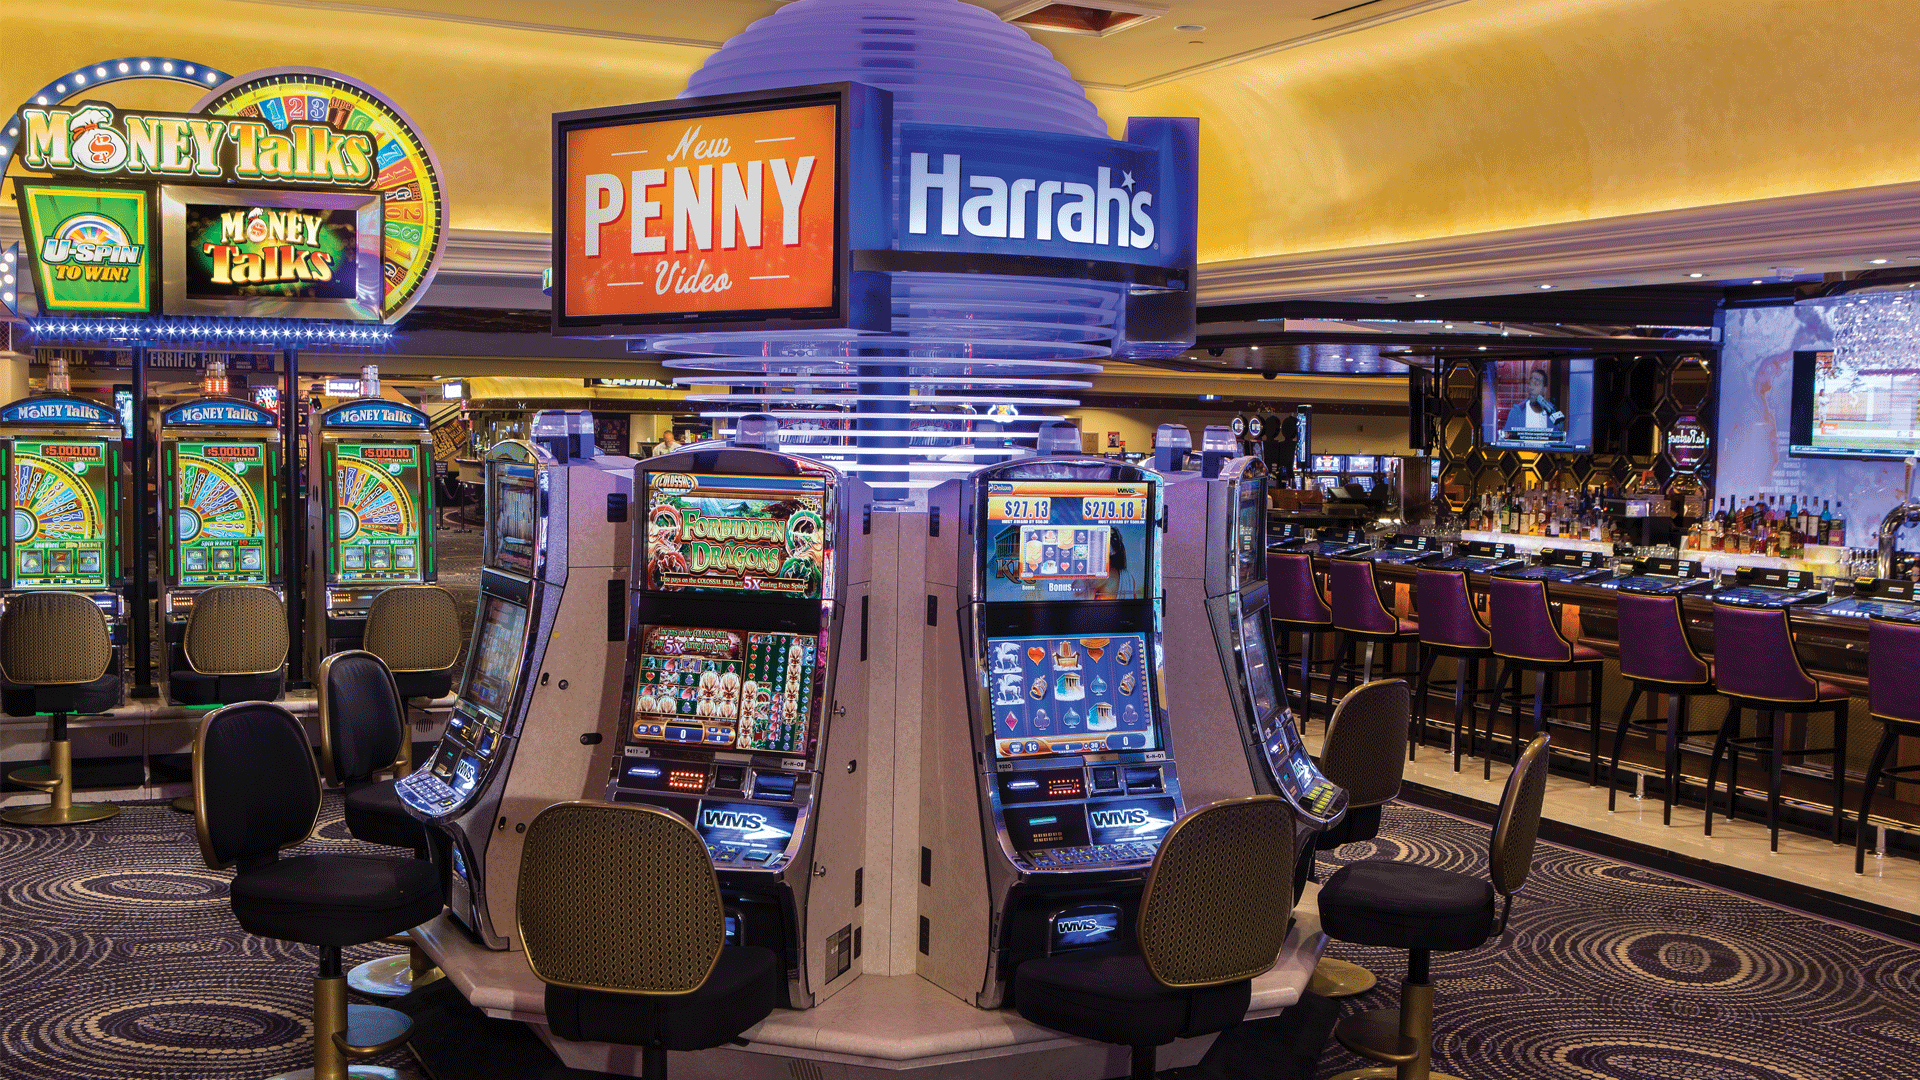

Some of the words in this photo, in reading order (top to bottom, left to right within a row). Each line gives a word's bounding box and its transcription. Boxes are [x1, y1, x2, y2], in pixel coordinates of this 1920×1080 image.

[23, 105, 226, 173] MONEY
[229, 121, 370, 183] Talks
[666, 125, 732, 162] New
[585, 155, 817, 259] PENNY
[909, 152, 1155, 249] Harrah's
[220, 207, 323, 247] MONEY
[42, 239, 142, 266] U-SPIN
[56, 265, 82, 281] TO
[85, 265, 130, 282] WIN!
[204, 242, 334, 285] Talks
[655, 259, 733, 295] Video
[150, 351, 197, 368] ERRIFIC
[18, 404, 63, 419] MONEY
[65, 404, 99, 420] Talks
[182, 407, 224, 421] MONEY
[226, 407, 258, 422] Talks
[340, 409, 381, 423] MONEY
[381, 409, 412, 423] Talks
[1005, 500, 1049, 517] $27.13
[1084, 501, 1134, 518] $279.18
[681, 508, 787, 545] FORBIDDEN
[690, 541, 781, 575] DRAGONS
[1049, 583, 1082, 593] Bonus...
[704, 809, 763, 830] WMS
[1091, 808, 1147, 828] WMS
[1058, 919, 1097, 934] WMS
